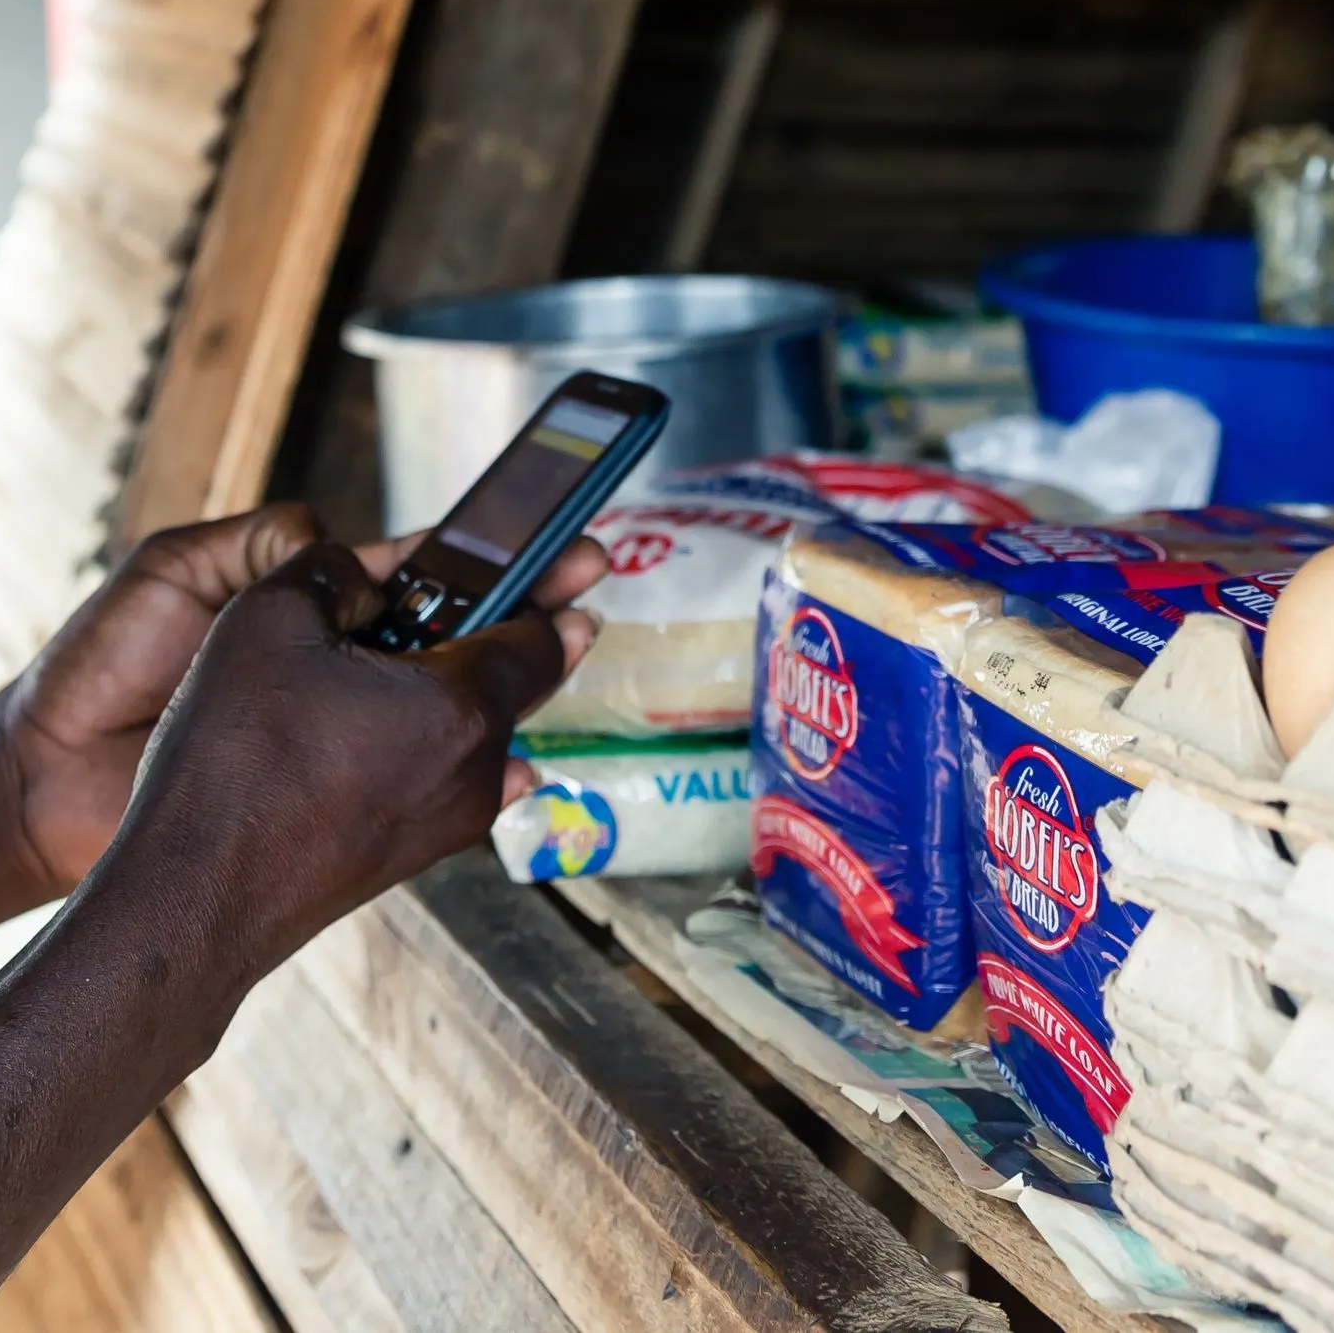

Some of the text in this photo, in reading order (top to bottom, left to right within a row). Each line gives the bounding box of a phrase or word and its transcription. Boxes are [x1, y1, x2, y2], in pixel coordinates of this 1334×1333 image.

[654, 768, 751, 805] VALU
[1005, 767, 1062, 816] fresh
[994, 787, 1087, 906] LOBEL'S
[1011, 871, 1060, 933] BREAD
[1018, 989, 1068, 1050] WHITE
[1069, 1036, 1117, 1097] LOAF
